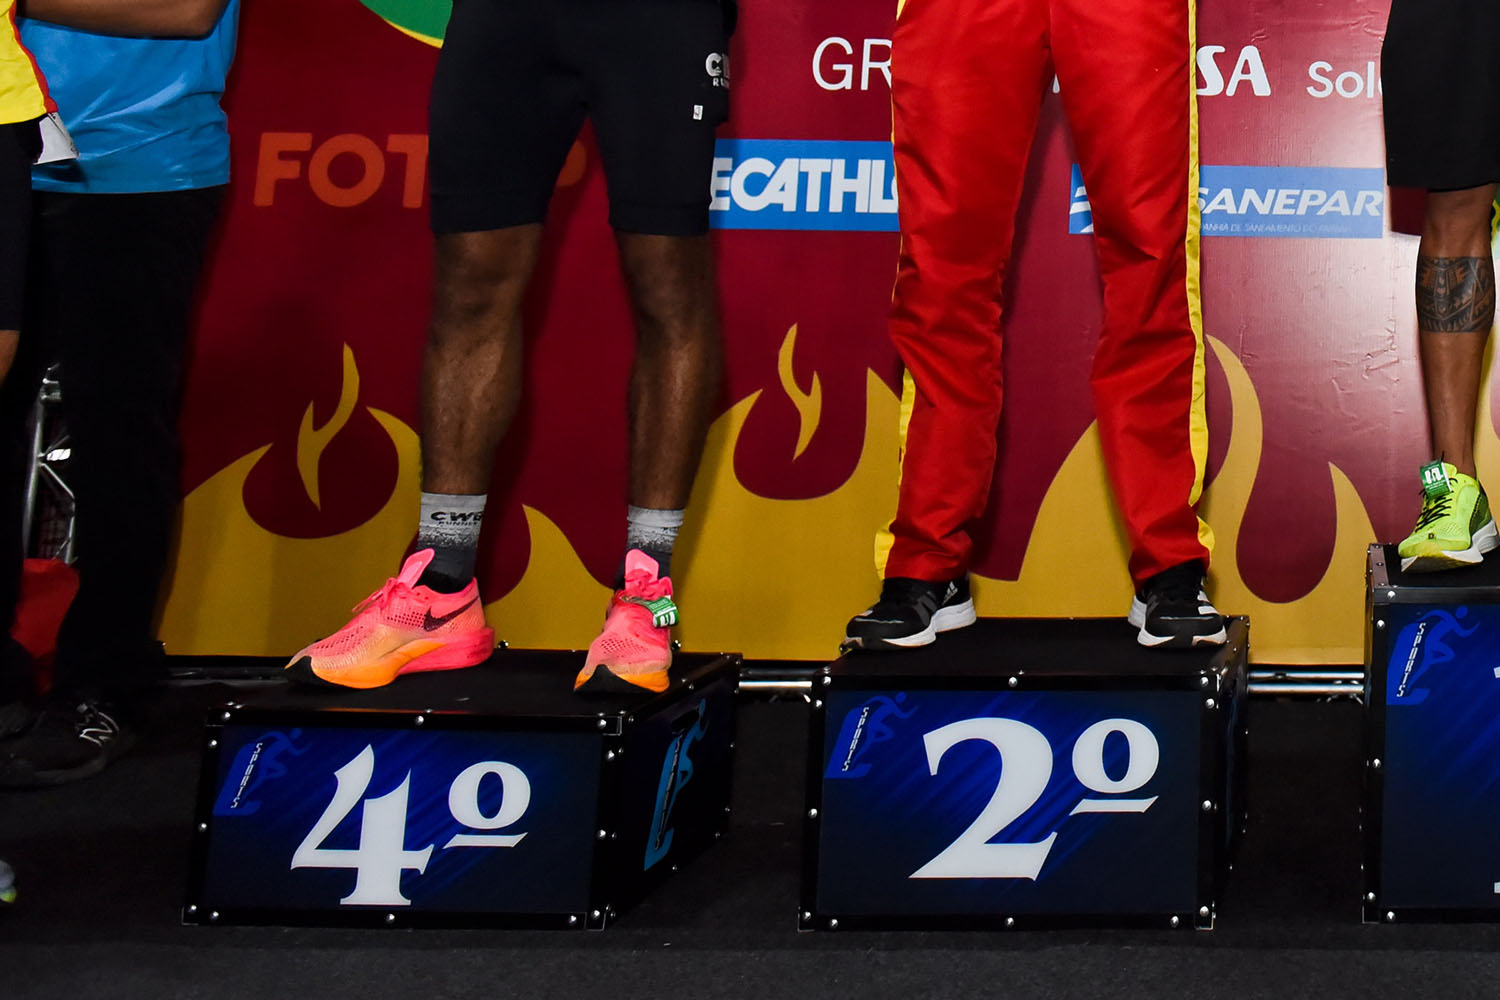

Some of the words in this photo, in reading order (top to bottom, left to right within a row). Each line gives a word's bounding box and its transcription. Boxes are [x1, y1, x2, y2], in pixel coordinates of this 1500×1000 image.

[1306, 61, 1382, 98] Sol
[710, 157, 897, 214] ECATHL
[1196, 187, 1384, 216] SANEPAR
[1396, 622, 1426, 698] SPORTS
[842, 706, 870, 772] SPORTS
[230, 743, 263, 809] SPORTS
[907, 717, 1160, 881] 2º
[290, 744, 531, 906] 4º
